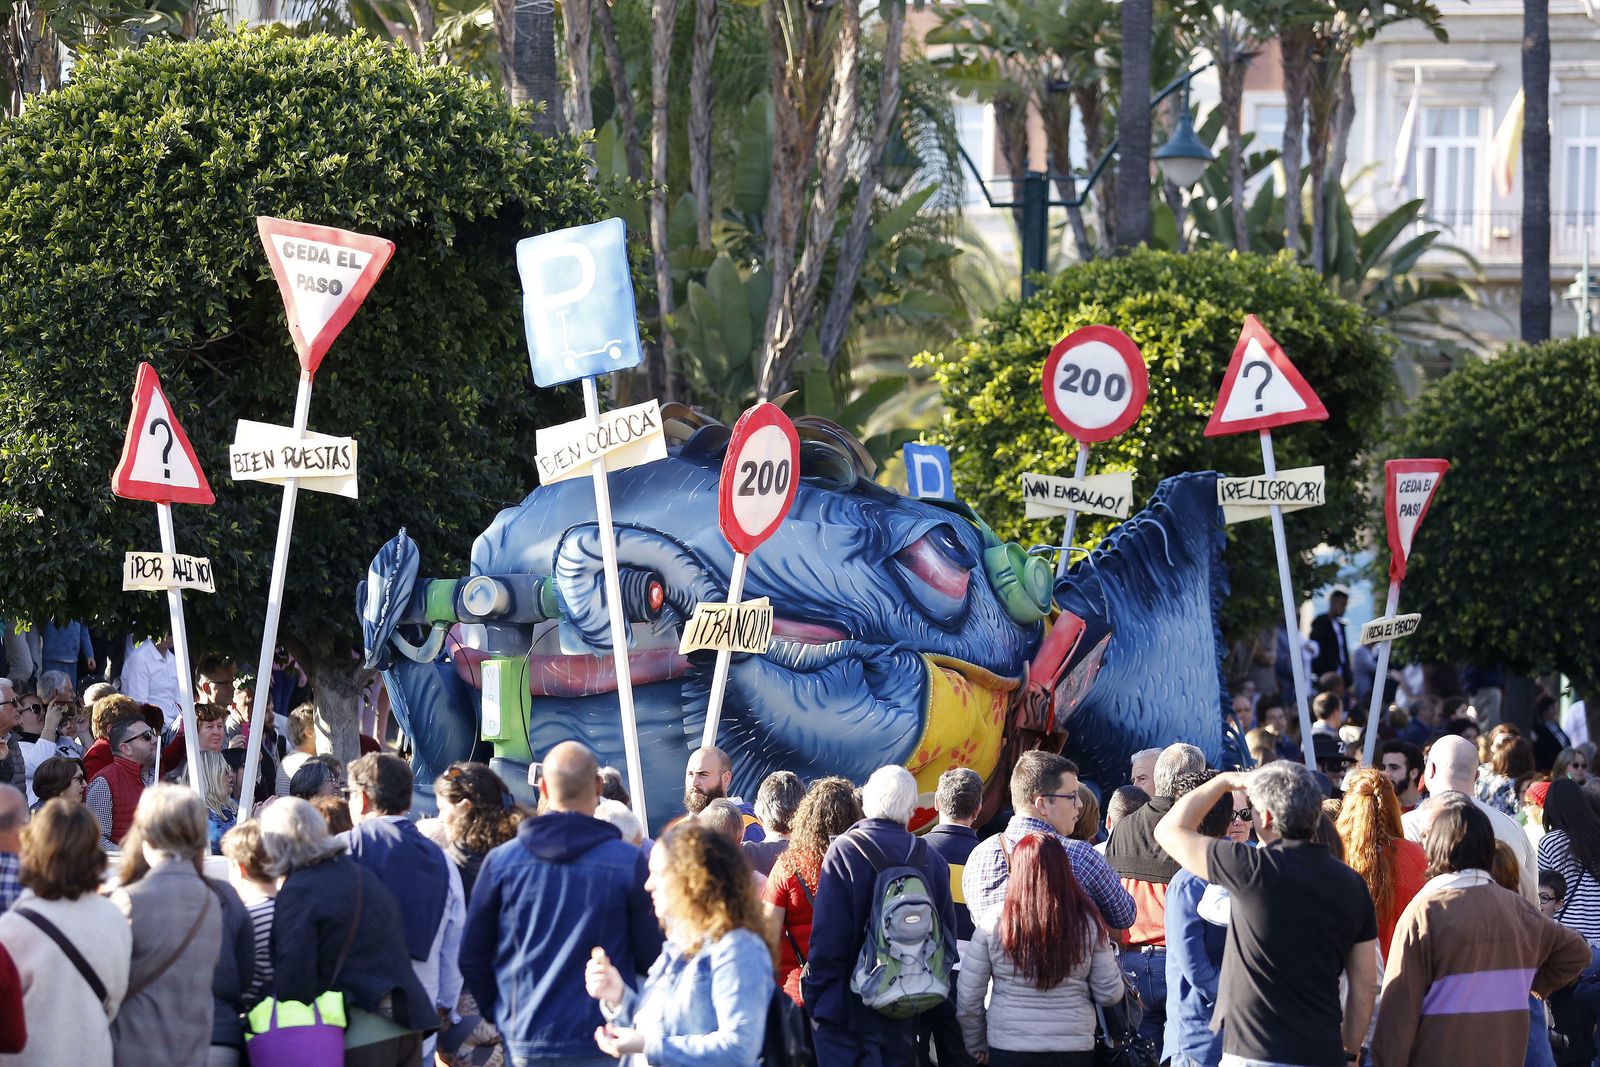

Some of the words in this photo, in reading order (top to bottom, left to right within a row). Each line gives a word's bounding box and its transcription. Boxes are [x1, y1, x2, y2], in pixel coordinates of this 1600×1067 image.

[282, 241, 331, 264] CEDA
[336, 250, 362, 270] EL
[296, 273, 343, 296] PASO
[523, 241, 596, 360] P
[1059, 363, 1126, 402] 200
[1242, 360, 1273, 412] ?
[149, 417, 173, 479] ?
[233, 449, 275, 473] BIEN
[281, 445, 351, 472] PUESTAS
[540, 442, 581, 478] BIEN
[737, 459, 790, 497] 200
[1399, 479, 1422, 494] CEDA
[1422, 479, 1432, 493] EL
[1054, 485, 1125, 513] EMBALAO!
[131, 555, 164, 582] ¡POR
